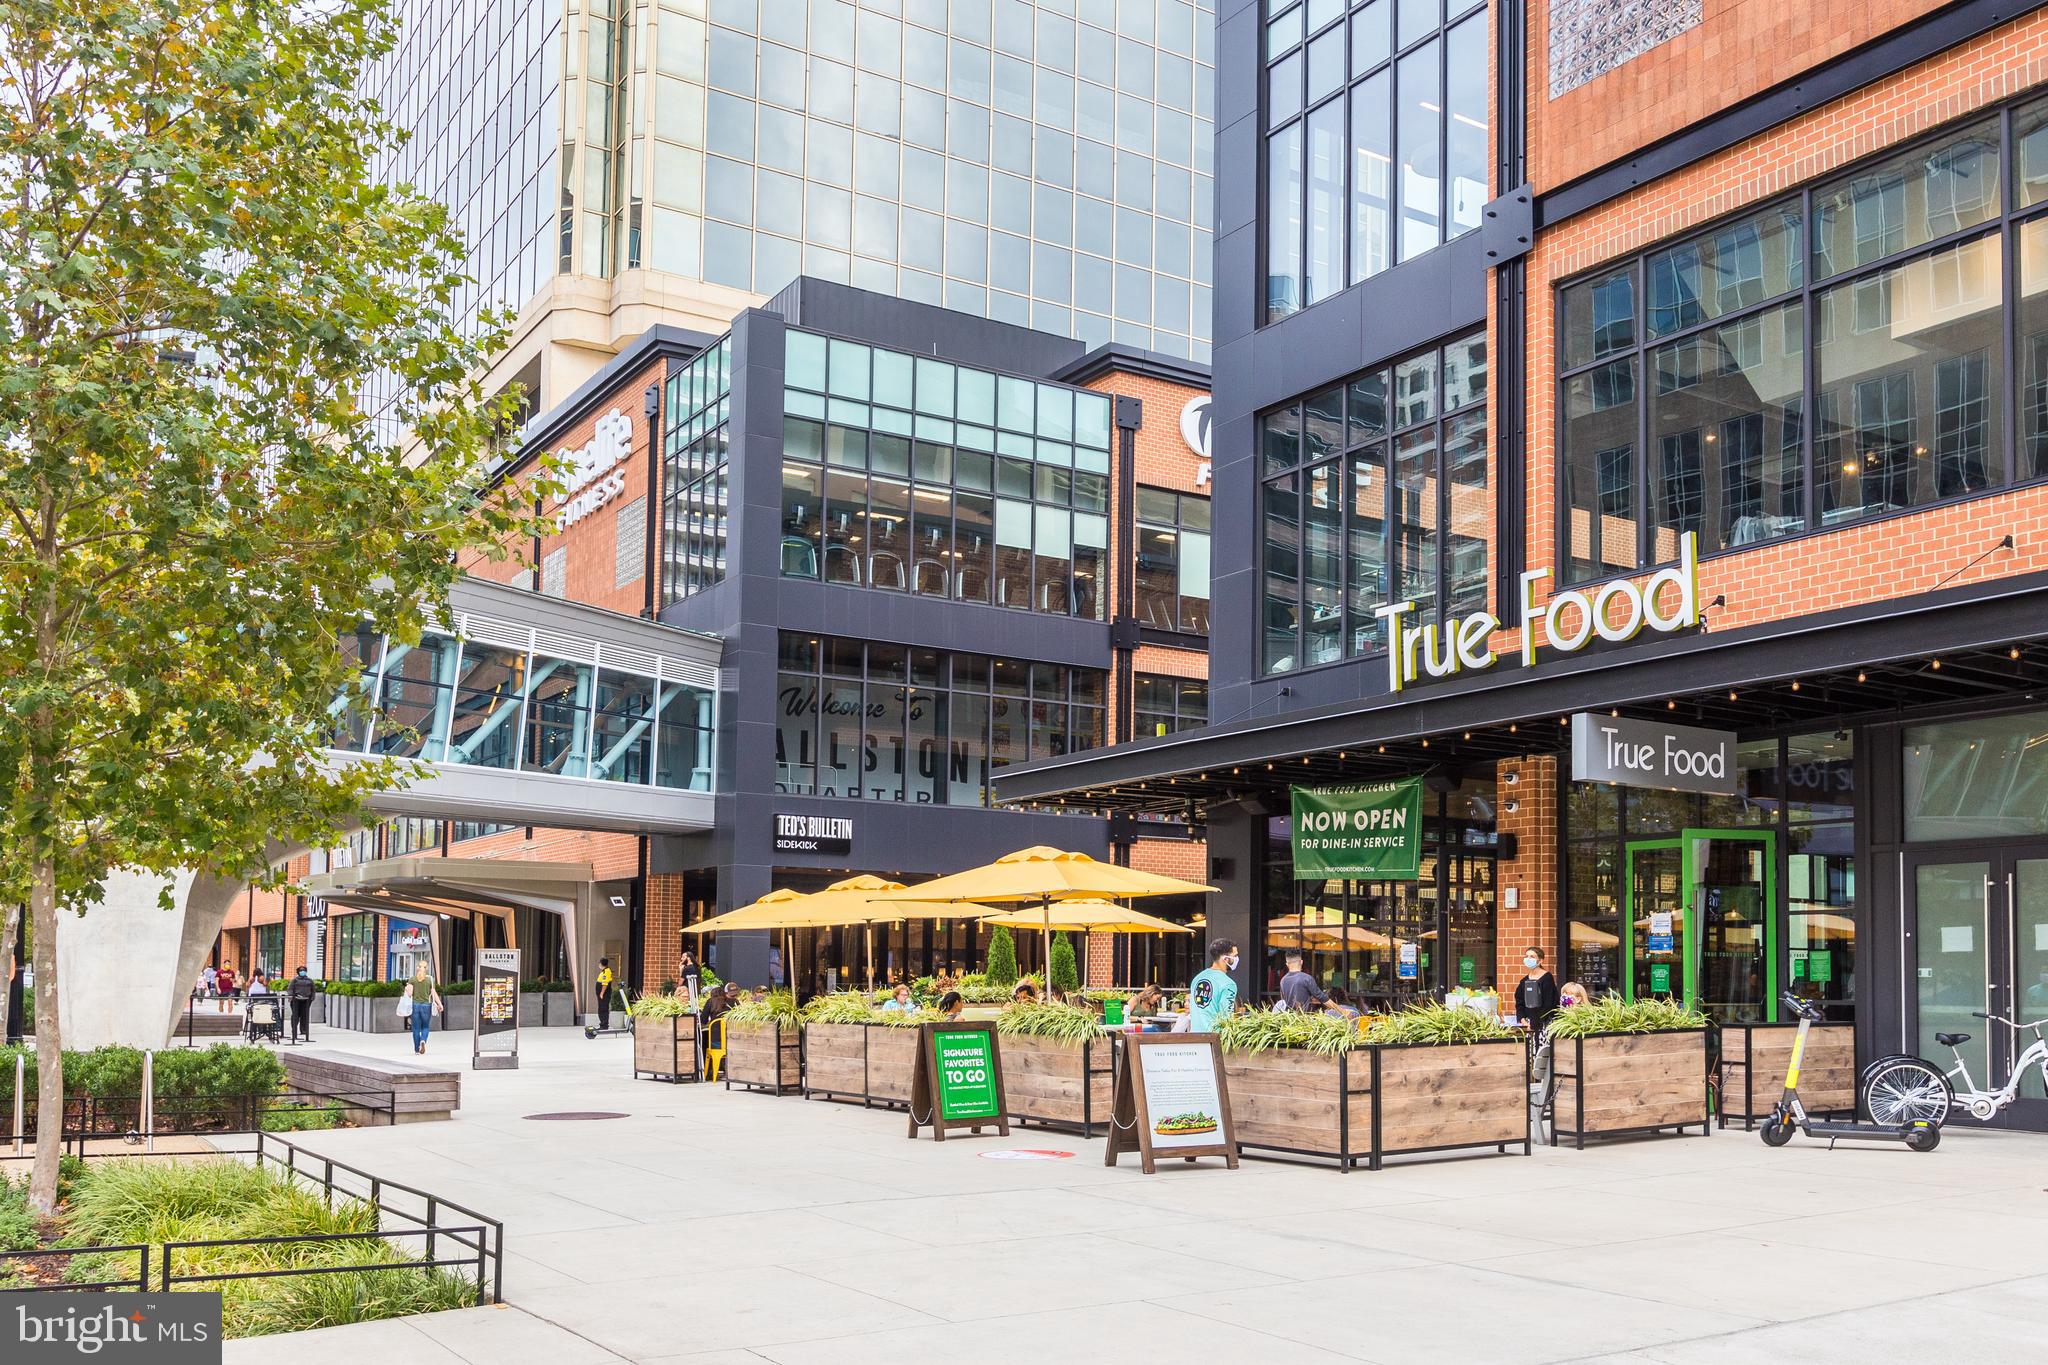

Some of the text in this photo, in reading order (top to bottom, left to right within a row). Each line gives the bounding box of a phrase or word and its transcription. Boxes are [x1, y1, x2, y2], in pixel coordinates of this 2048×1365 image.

[1374, 530, 1700, 693] True Food
[780, 686, 887, 718] Welcome
[1601, 727, 1725, 778] True Food
[777, 815, 853, 840] TED'S BULLETIN
[1301, 807, 1407, 832] NOW OPEN
[776, 840, 818, 850] SIDEKICK
[1301, 836, 1405, 849] FOR DINE-IN SERVICE
[943, 1048, 984, 1057] SIGNATURE
[944, 1058, 985, 1068] FAVORITES
[945, 1069, 986, 1083] TO GO
